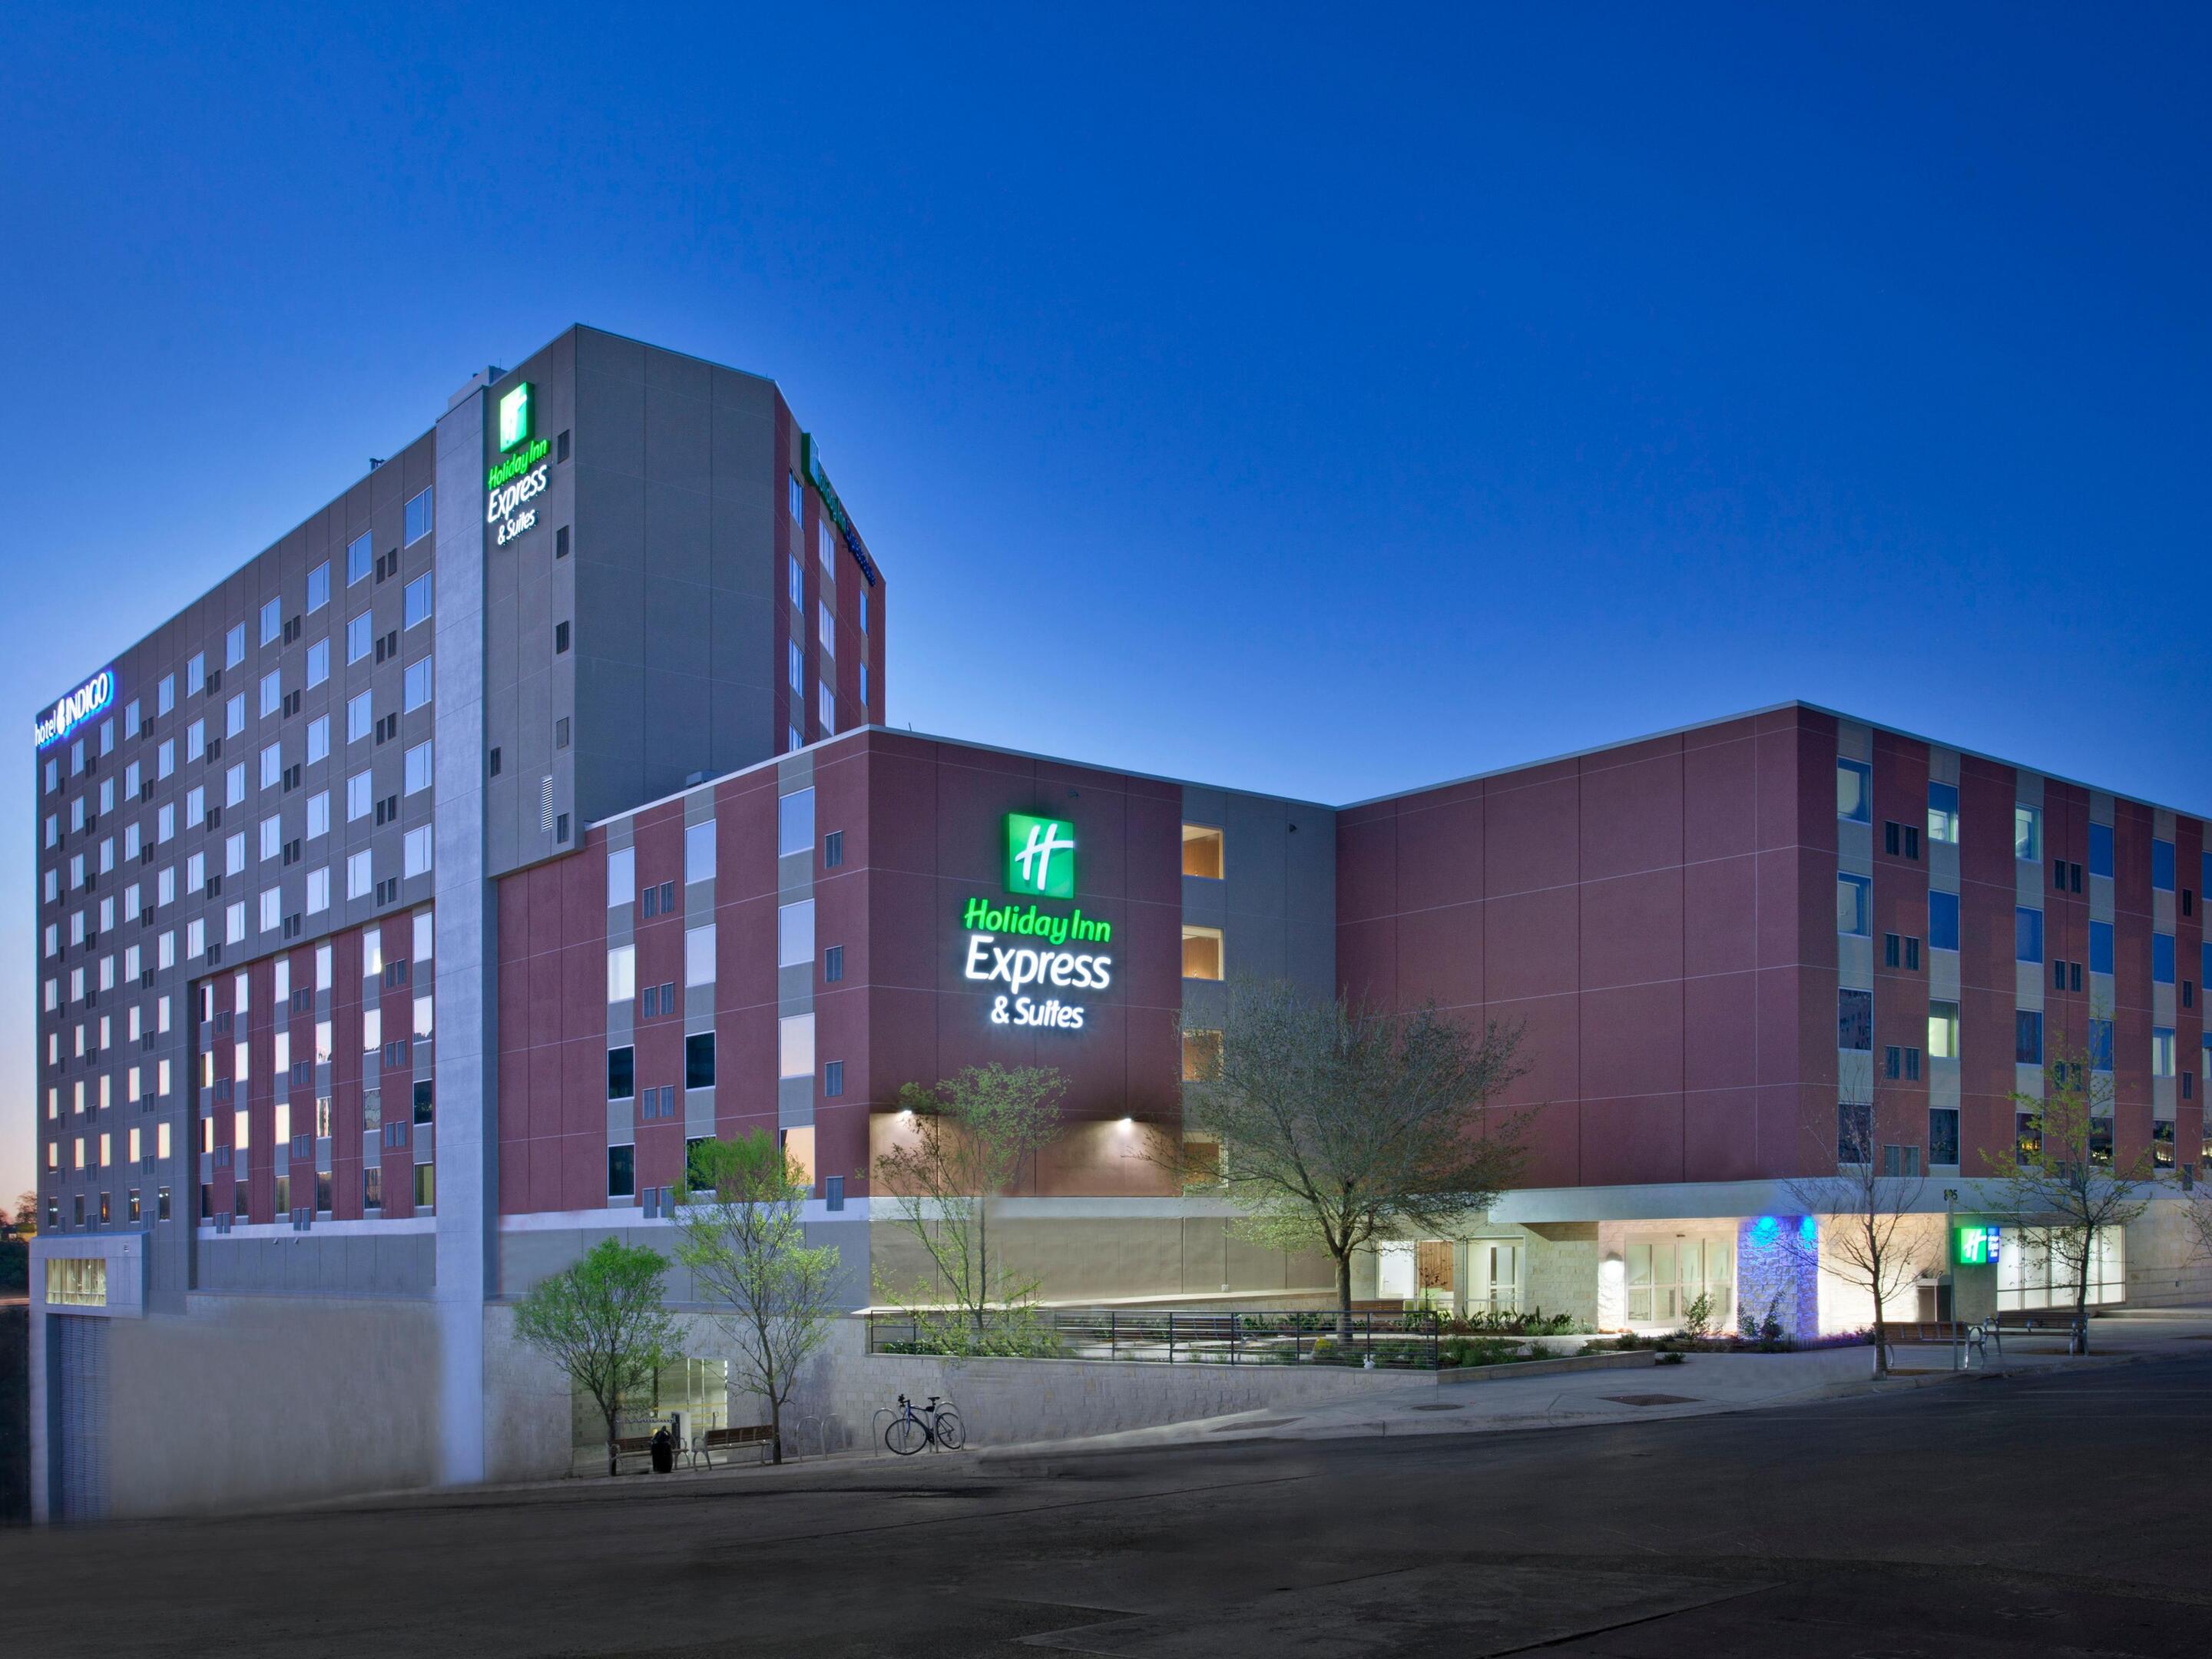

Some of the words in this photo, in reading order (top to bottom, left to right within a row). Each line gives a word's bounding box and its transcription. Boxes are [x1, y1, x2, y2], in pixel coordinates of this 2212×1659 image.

[488, 451, 528, 490] Holiday
[529, 439, 548, 463] Inn
[488, 464, 547, 522] Express
[498, 525, 506, 545] &
[506, 509, 535, 540] Suites
[35, 710, 56, 747] hotel
[65, 672, 108, 726] INDIGO
[965, 898, 1068, 945] Holiday
[1071, 909, 1111, 942] Inn
[965, 935, 1111, 995] Express
[991, 996, 1009, 1023] &
[1014, 998, 1084, 1028] Suites
